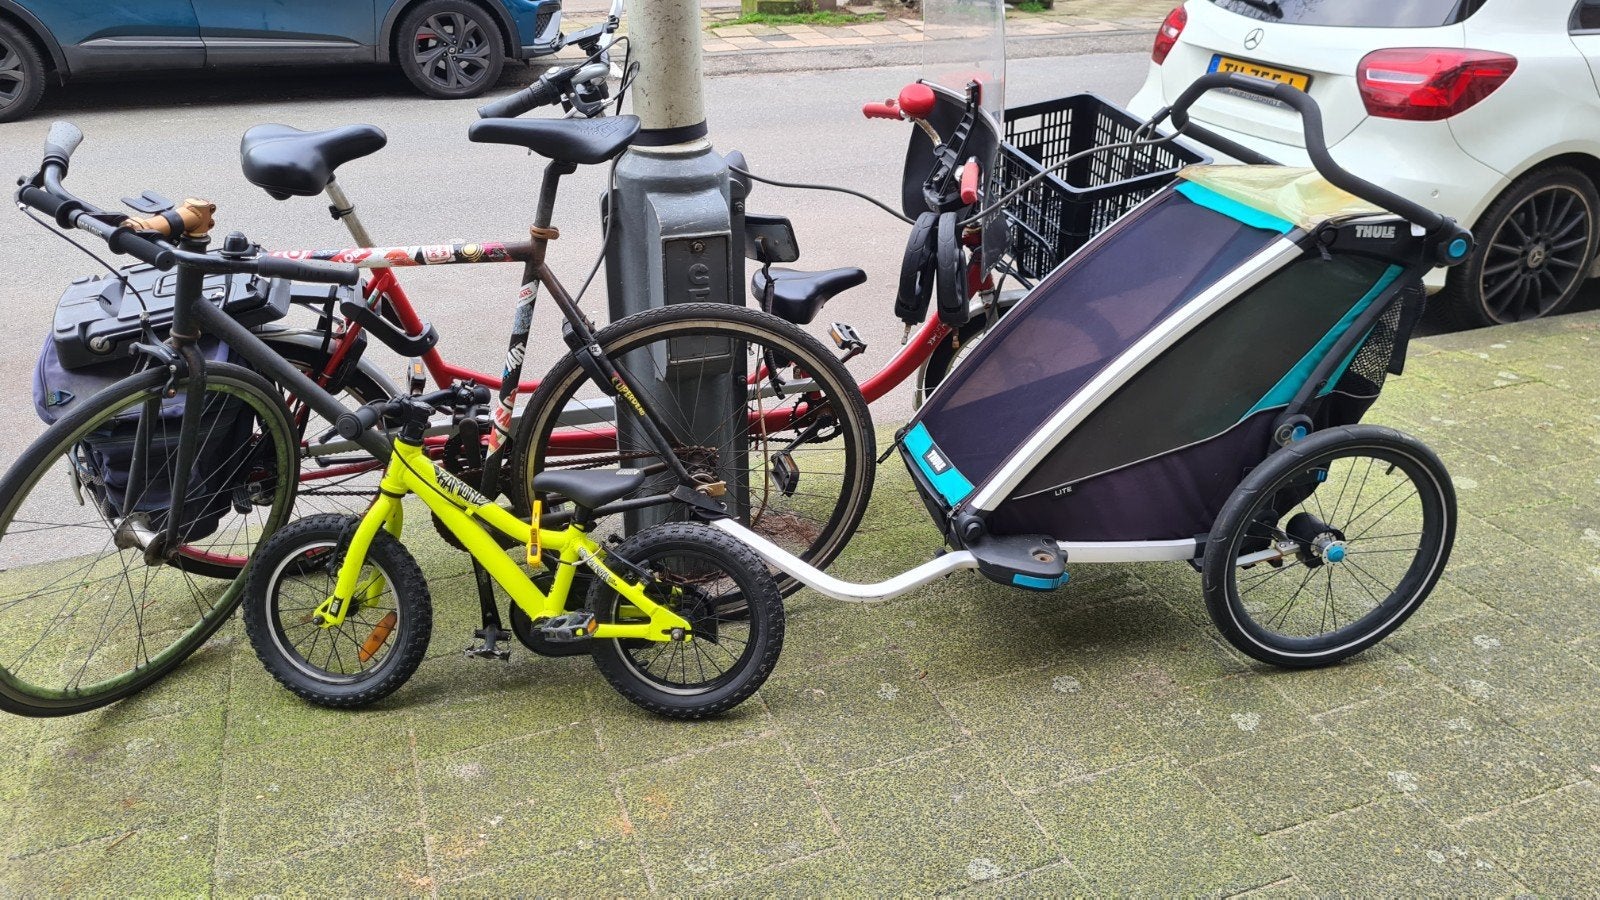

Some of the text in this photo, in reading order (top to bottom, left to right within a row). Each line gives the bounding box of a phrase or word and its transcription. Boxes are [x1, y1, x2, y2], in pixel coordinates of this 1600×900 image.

[1355, 225, 1396, 239] THULE
[927, 449, 947, 472] THULE
[1054, 485, 1073, 497] LITE
